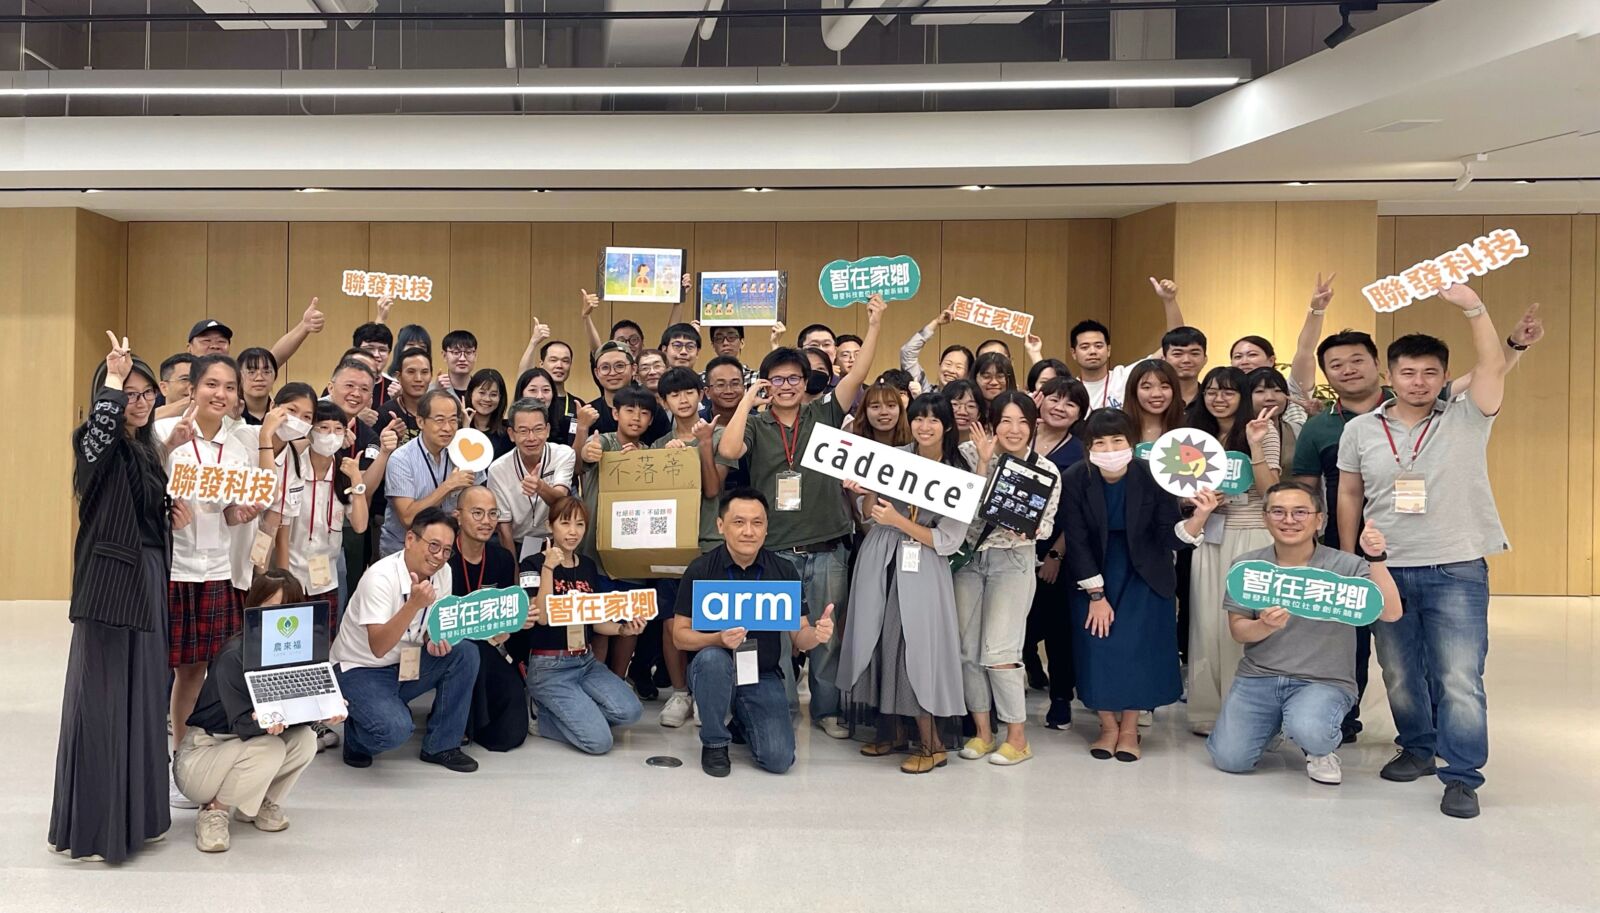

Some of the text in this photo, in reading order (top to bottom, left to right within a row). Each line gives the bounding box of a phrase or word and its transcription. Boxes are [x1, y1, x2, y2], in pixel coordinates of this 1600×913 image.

[345, 272, 430, 299] 聯發科技
[829, 263, 910, 292] 智在家鄉
[1367, 232, 1524, 309] 聯發科技
[954, 299, 1030, 336] 智在家鄉
[170, 463, 275, 504] 聯發科技
[549, 591, 657, 623] 智在家鄉
[701, 592, 793, 621] arm
[1243, 567, 1369, 610] 智在家鄉
[438, 593, 519, 631] 智在家鄉
